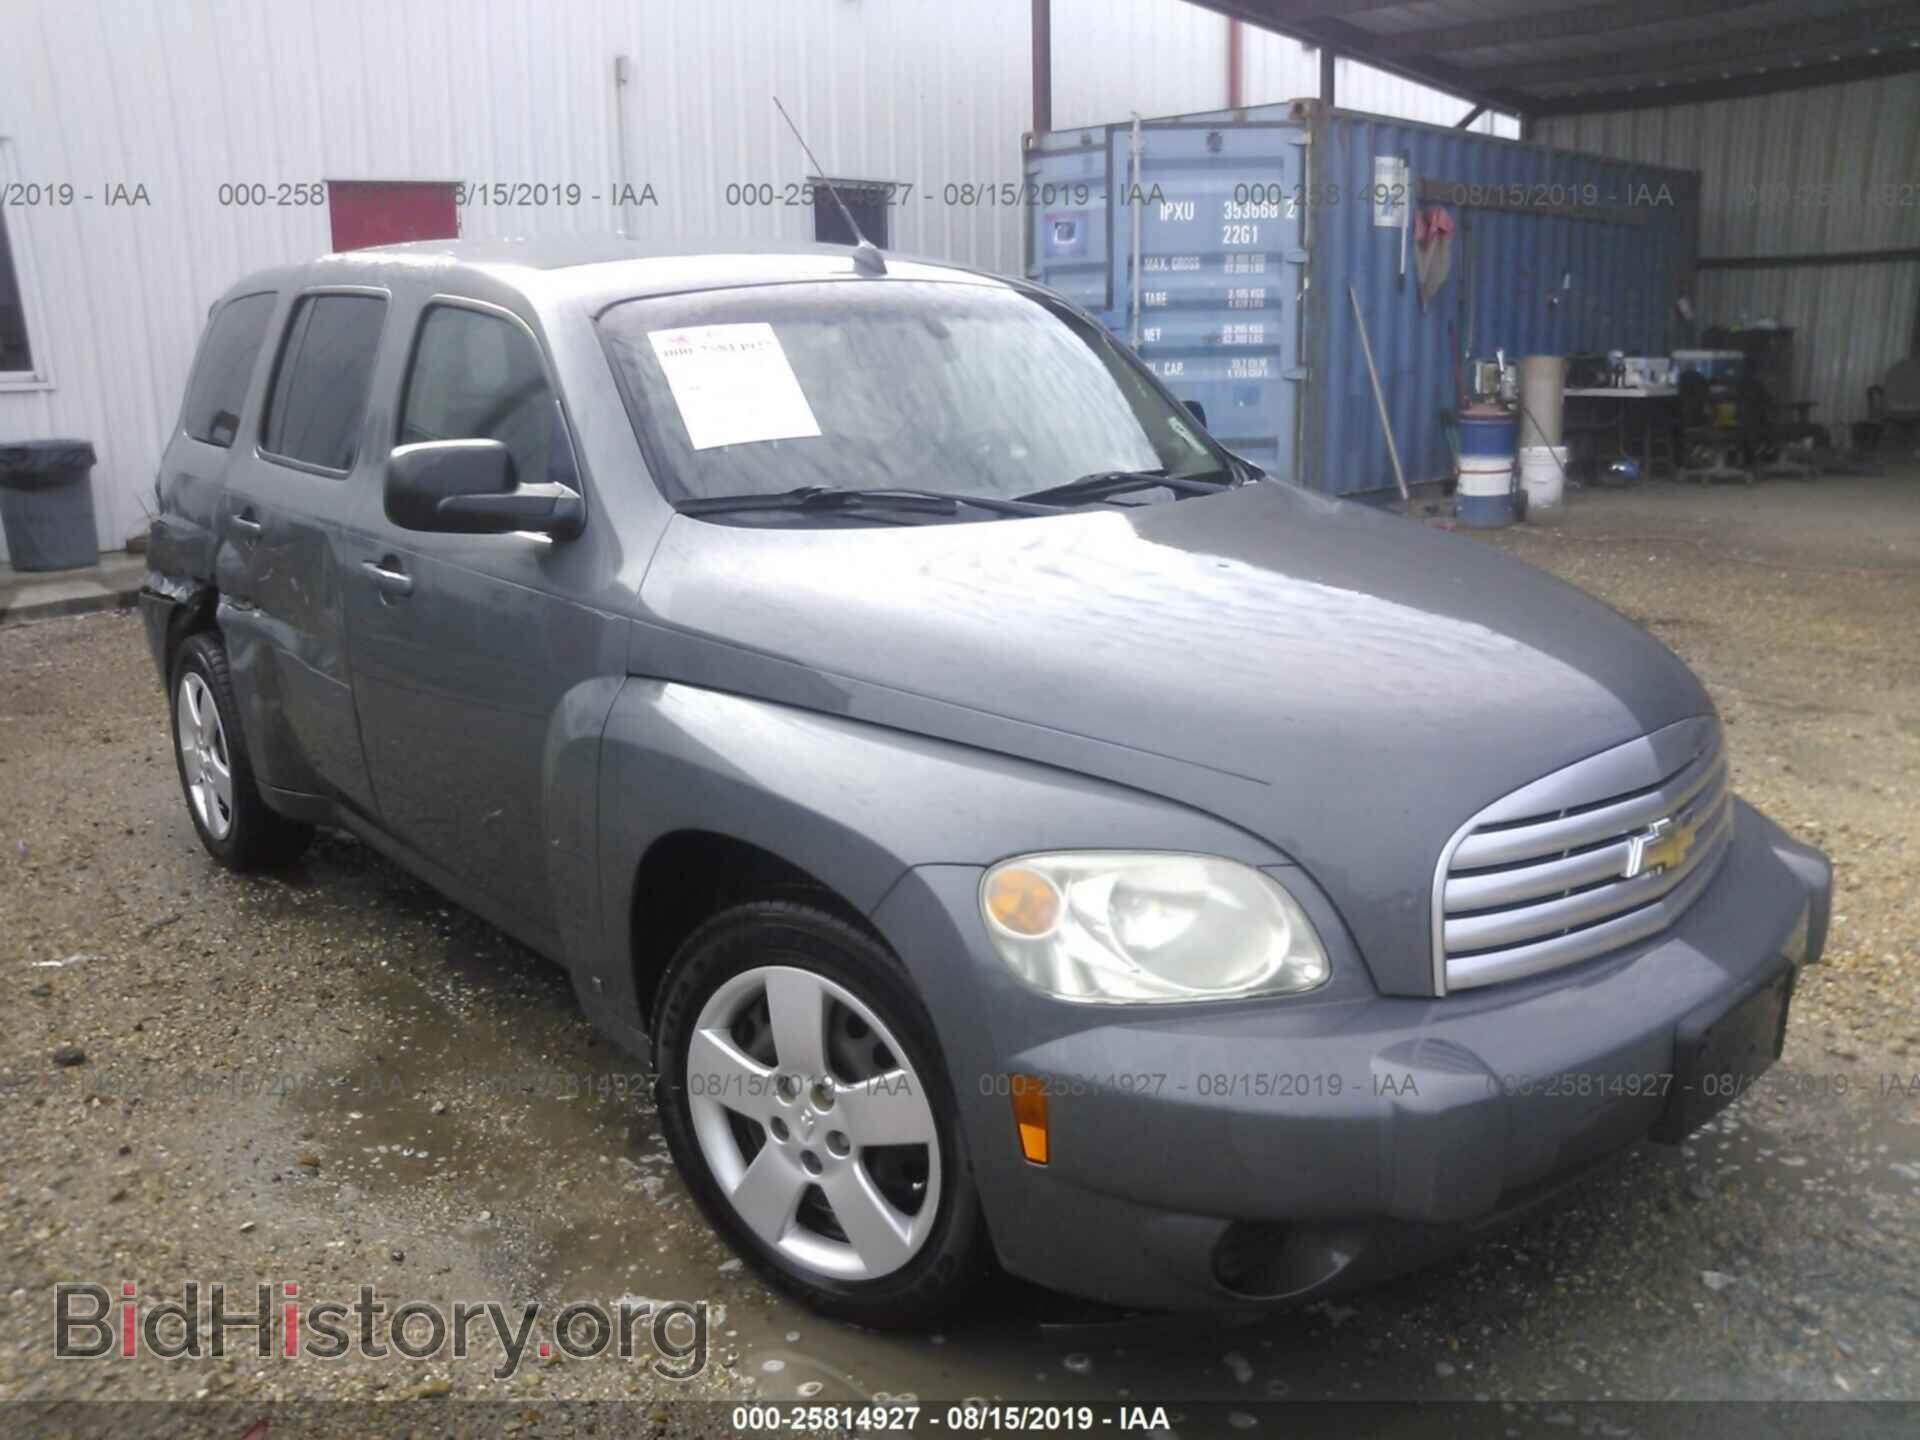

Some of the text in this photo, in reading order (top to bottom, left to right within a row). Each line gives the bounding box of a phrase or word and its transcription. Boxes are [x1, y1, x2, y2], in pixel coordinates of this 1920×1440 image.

[1160, 201, 1195, 221] IPXU
[1286, 200, 1297, 220] 2
[1223, 225, 1259, 245] 22G1
[1144, 327, 1161, 342] NET
